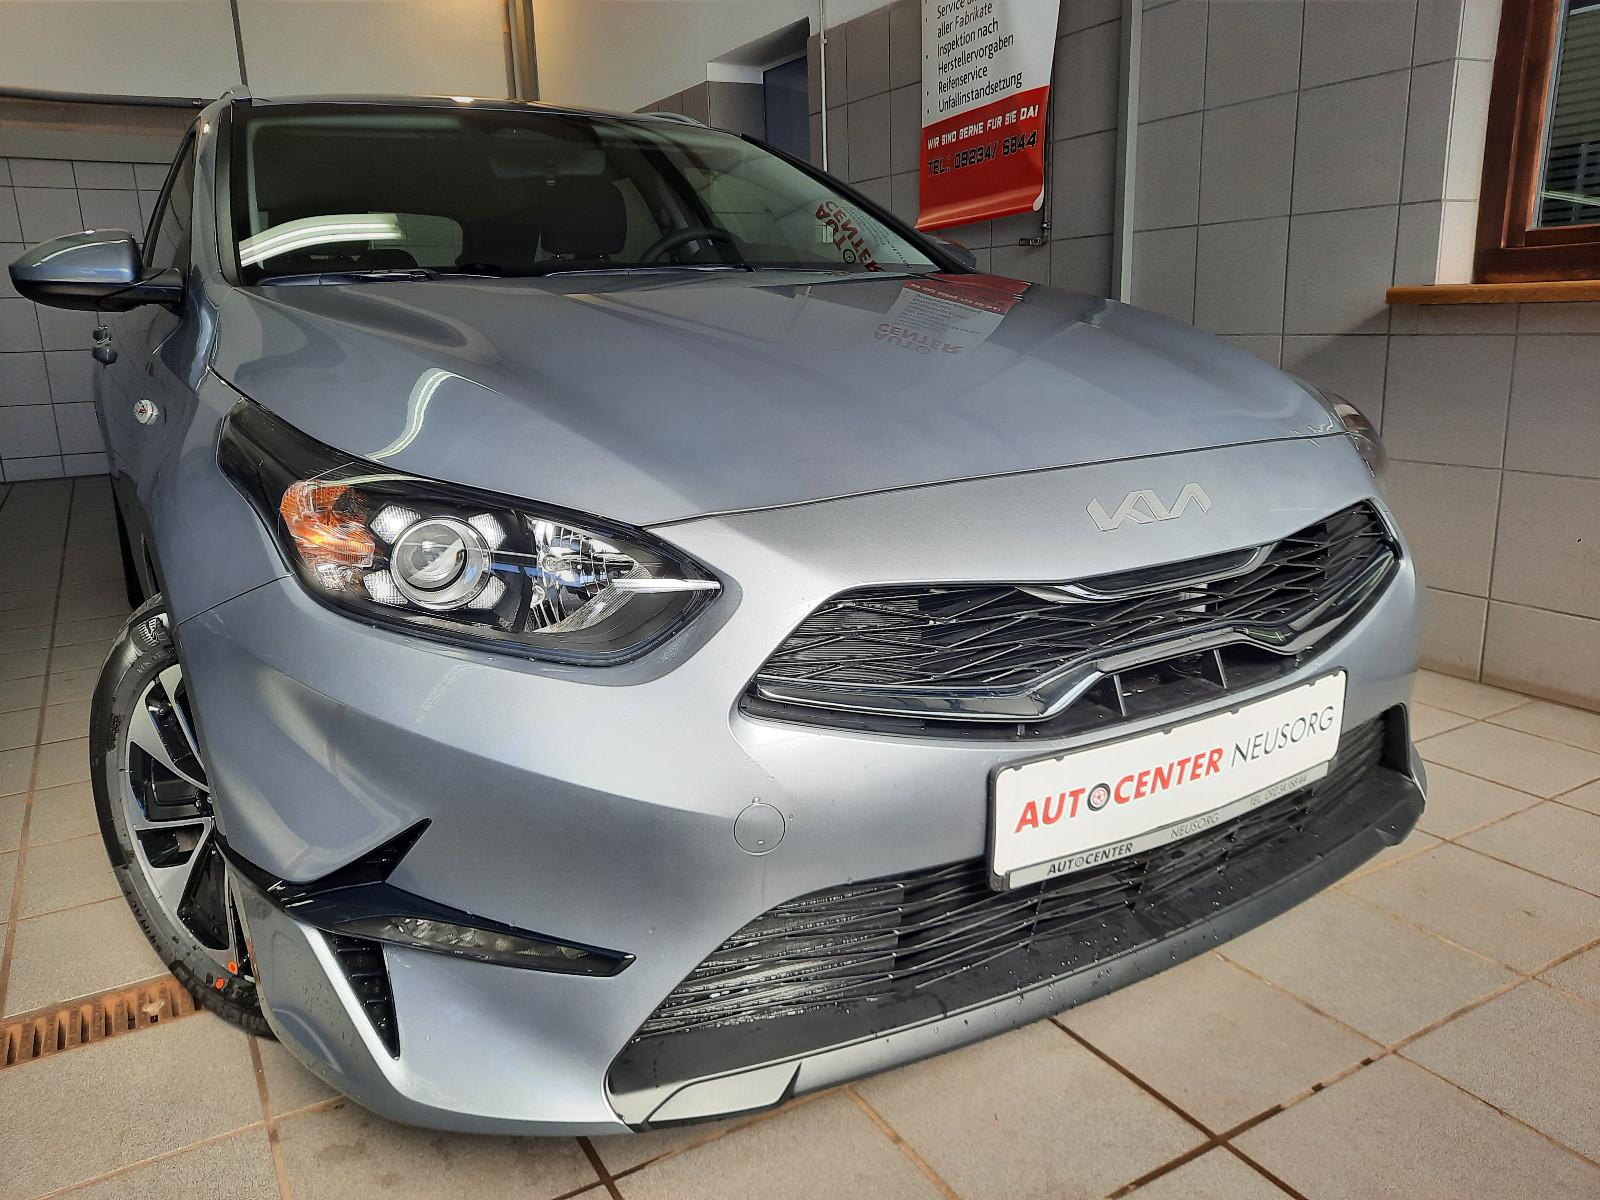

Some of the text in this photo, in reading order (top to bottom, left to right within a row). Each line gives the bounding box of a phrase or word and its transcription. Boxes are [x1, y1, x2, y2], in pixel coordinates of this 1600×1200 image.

[937, 0, 965, 19] Service
[937, 3, 993, 38] aller Fabrikate
[937, 17, 999, 58] Inspektion nach
[938, 34, 1014, 76] Herstellervorgaben
[938, 66, 988, 95] Reifenservice
[938, 72, 1023, 113] Unfallinstandsetzung
[927, 137, 940, 150] WIR
[1002, 130, 1037, 156] 6844
[1231, 705, 1335, 768] NEUSORG
[1170, 812, 1220, 840] NEUSORG
